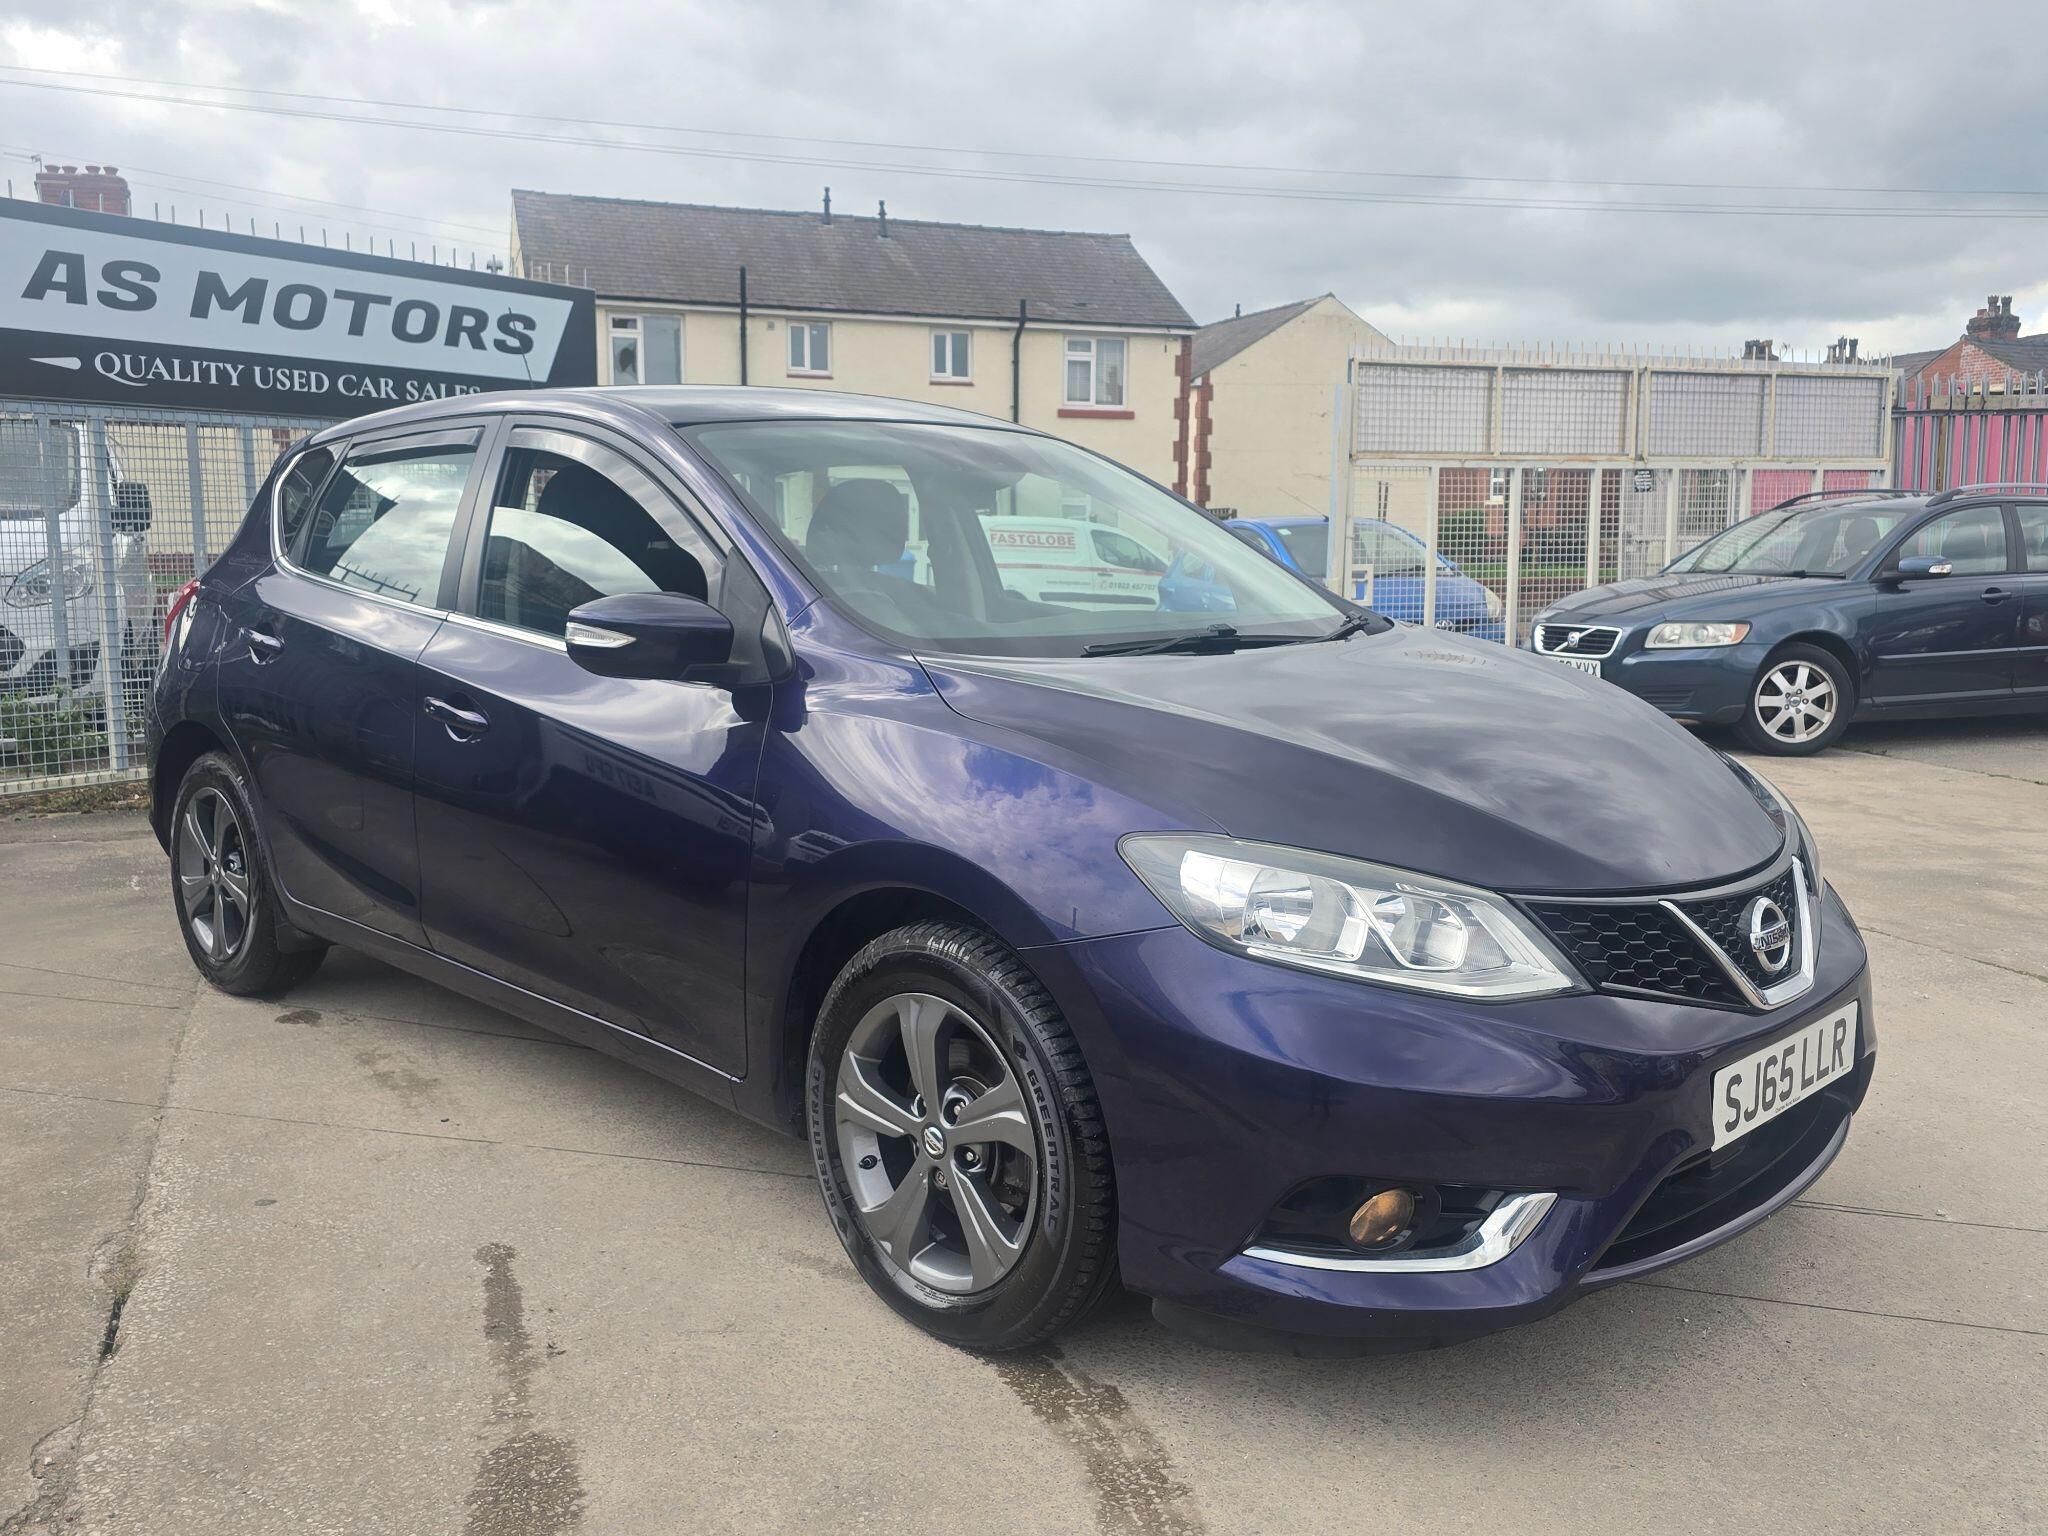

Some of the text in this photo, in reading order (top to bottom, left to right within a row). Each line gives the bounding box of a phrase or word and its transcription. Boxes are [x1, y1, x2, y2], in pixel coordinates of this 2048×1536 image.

[21, 249, 537, 355] AS MOTORS
[94, 352, 245, 387] QUALITY
[254, 366, 330, 393] USED
[337, 374, 400, 400] CAR
[990, 533, 1075, 546] FASTGLOBE
